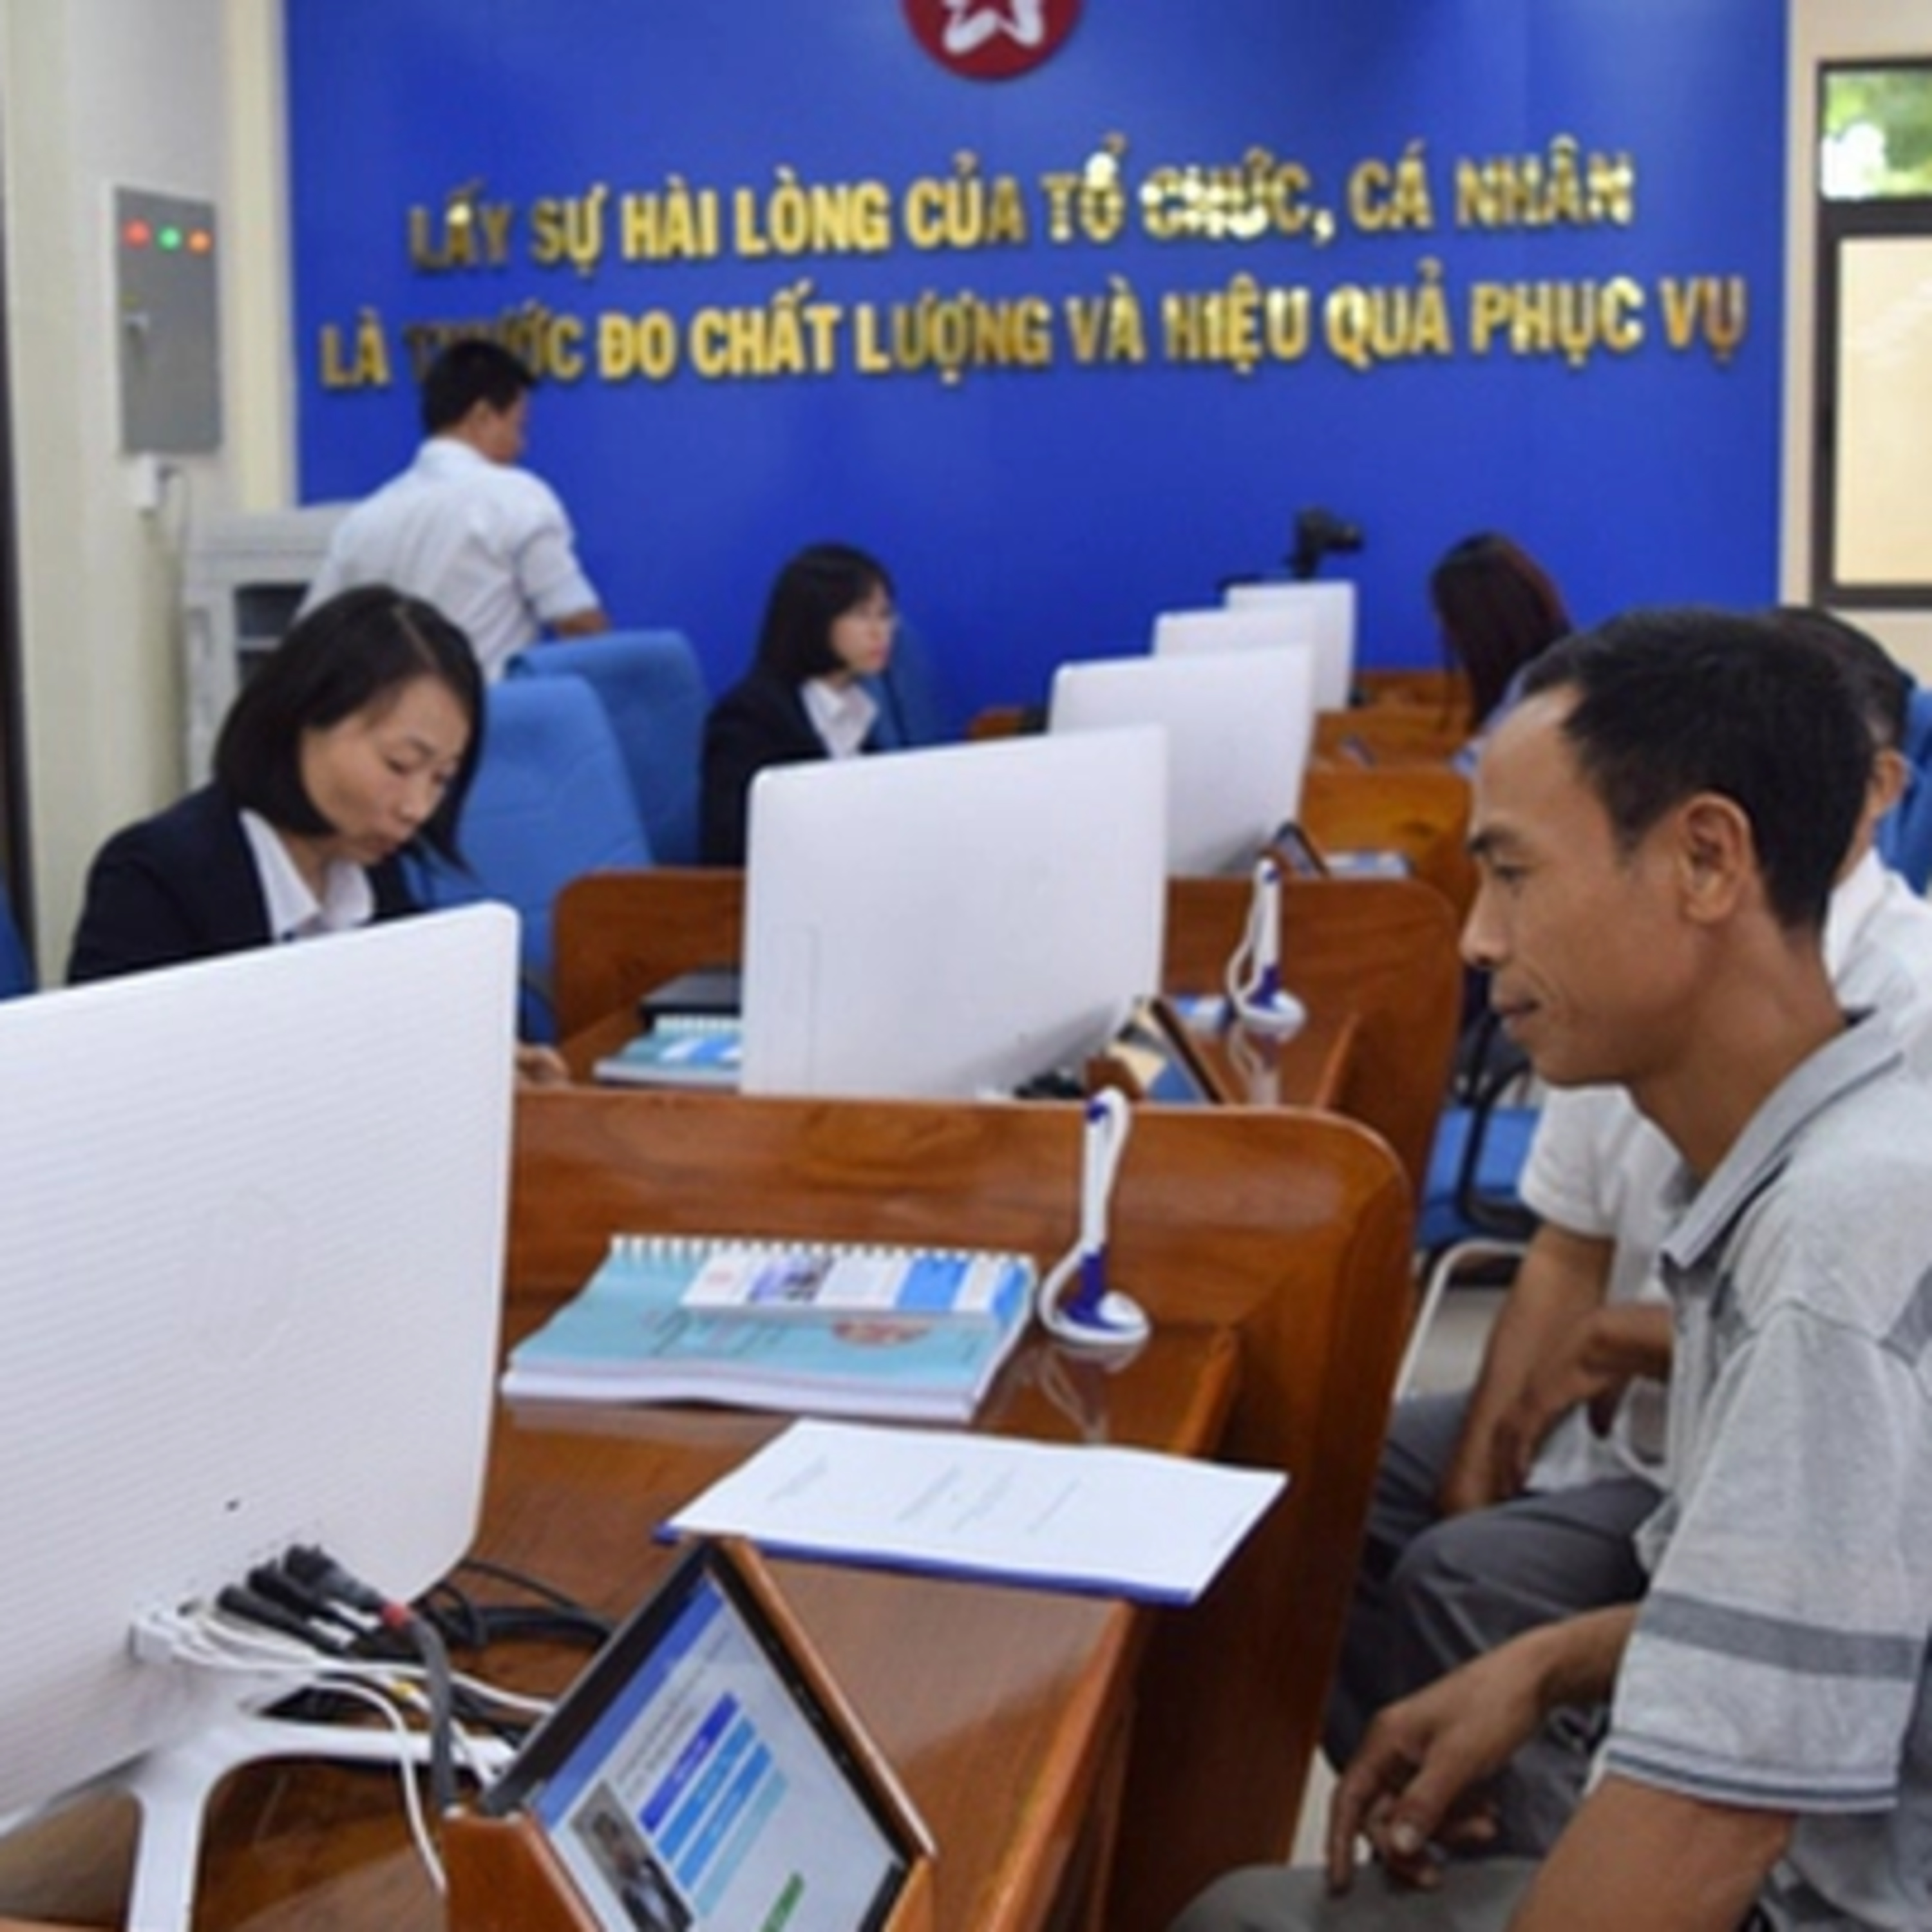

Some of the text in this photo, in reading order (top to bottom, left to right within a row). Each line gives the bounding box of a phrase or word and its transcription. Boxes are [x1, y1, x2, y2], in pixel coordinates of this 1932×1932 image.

[407, 176, 511, 269] LẤY
[531, 183, 607, 277] SỰ
[623, 173, 719, 258] HÀI
[734, 164, 890, 256] LÒNG
[905, 149, 1024, 247] CỦA
[1041, 134, 1124, 242] TỔ
[1350, 137, 1431, 229] CÁ
[1455, 134, 1634, 225] NHÂN
[321, 256, 1744, 386] LÀ TỚC ĐO CHẤT LƯỢNG VÀ HIỆU QUẢ PHỤC VỤ
